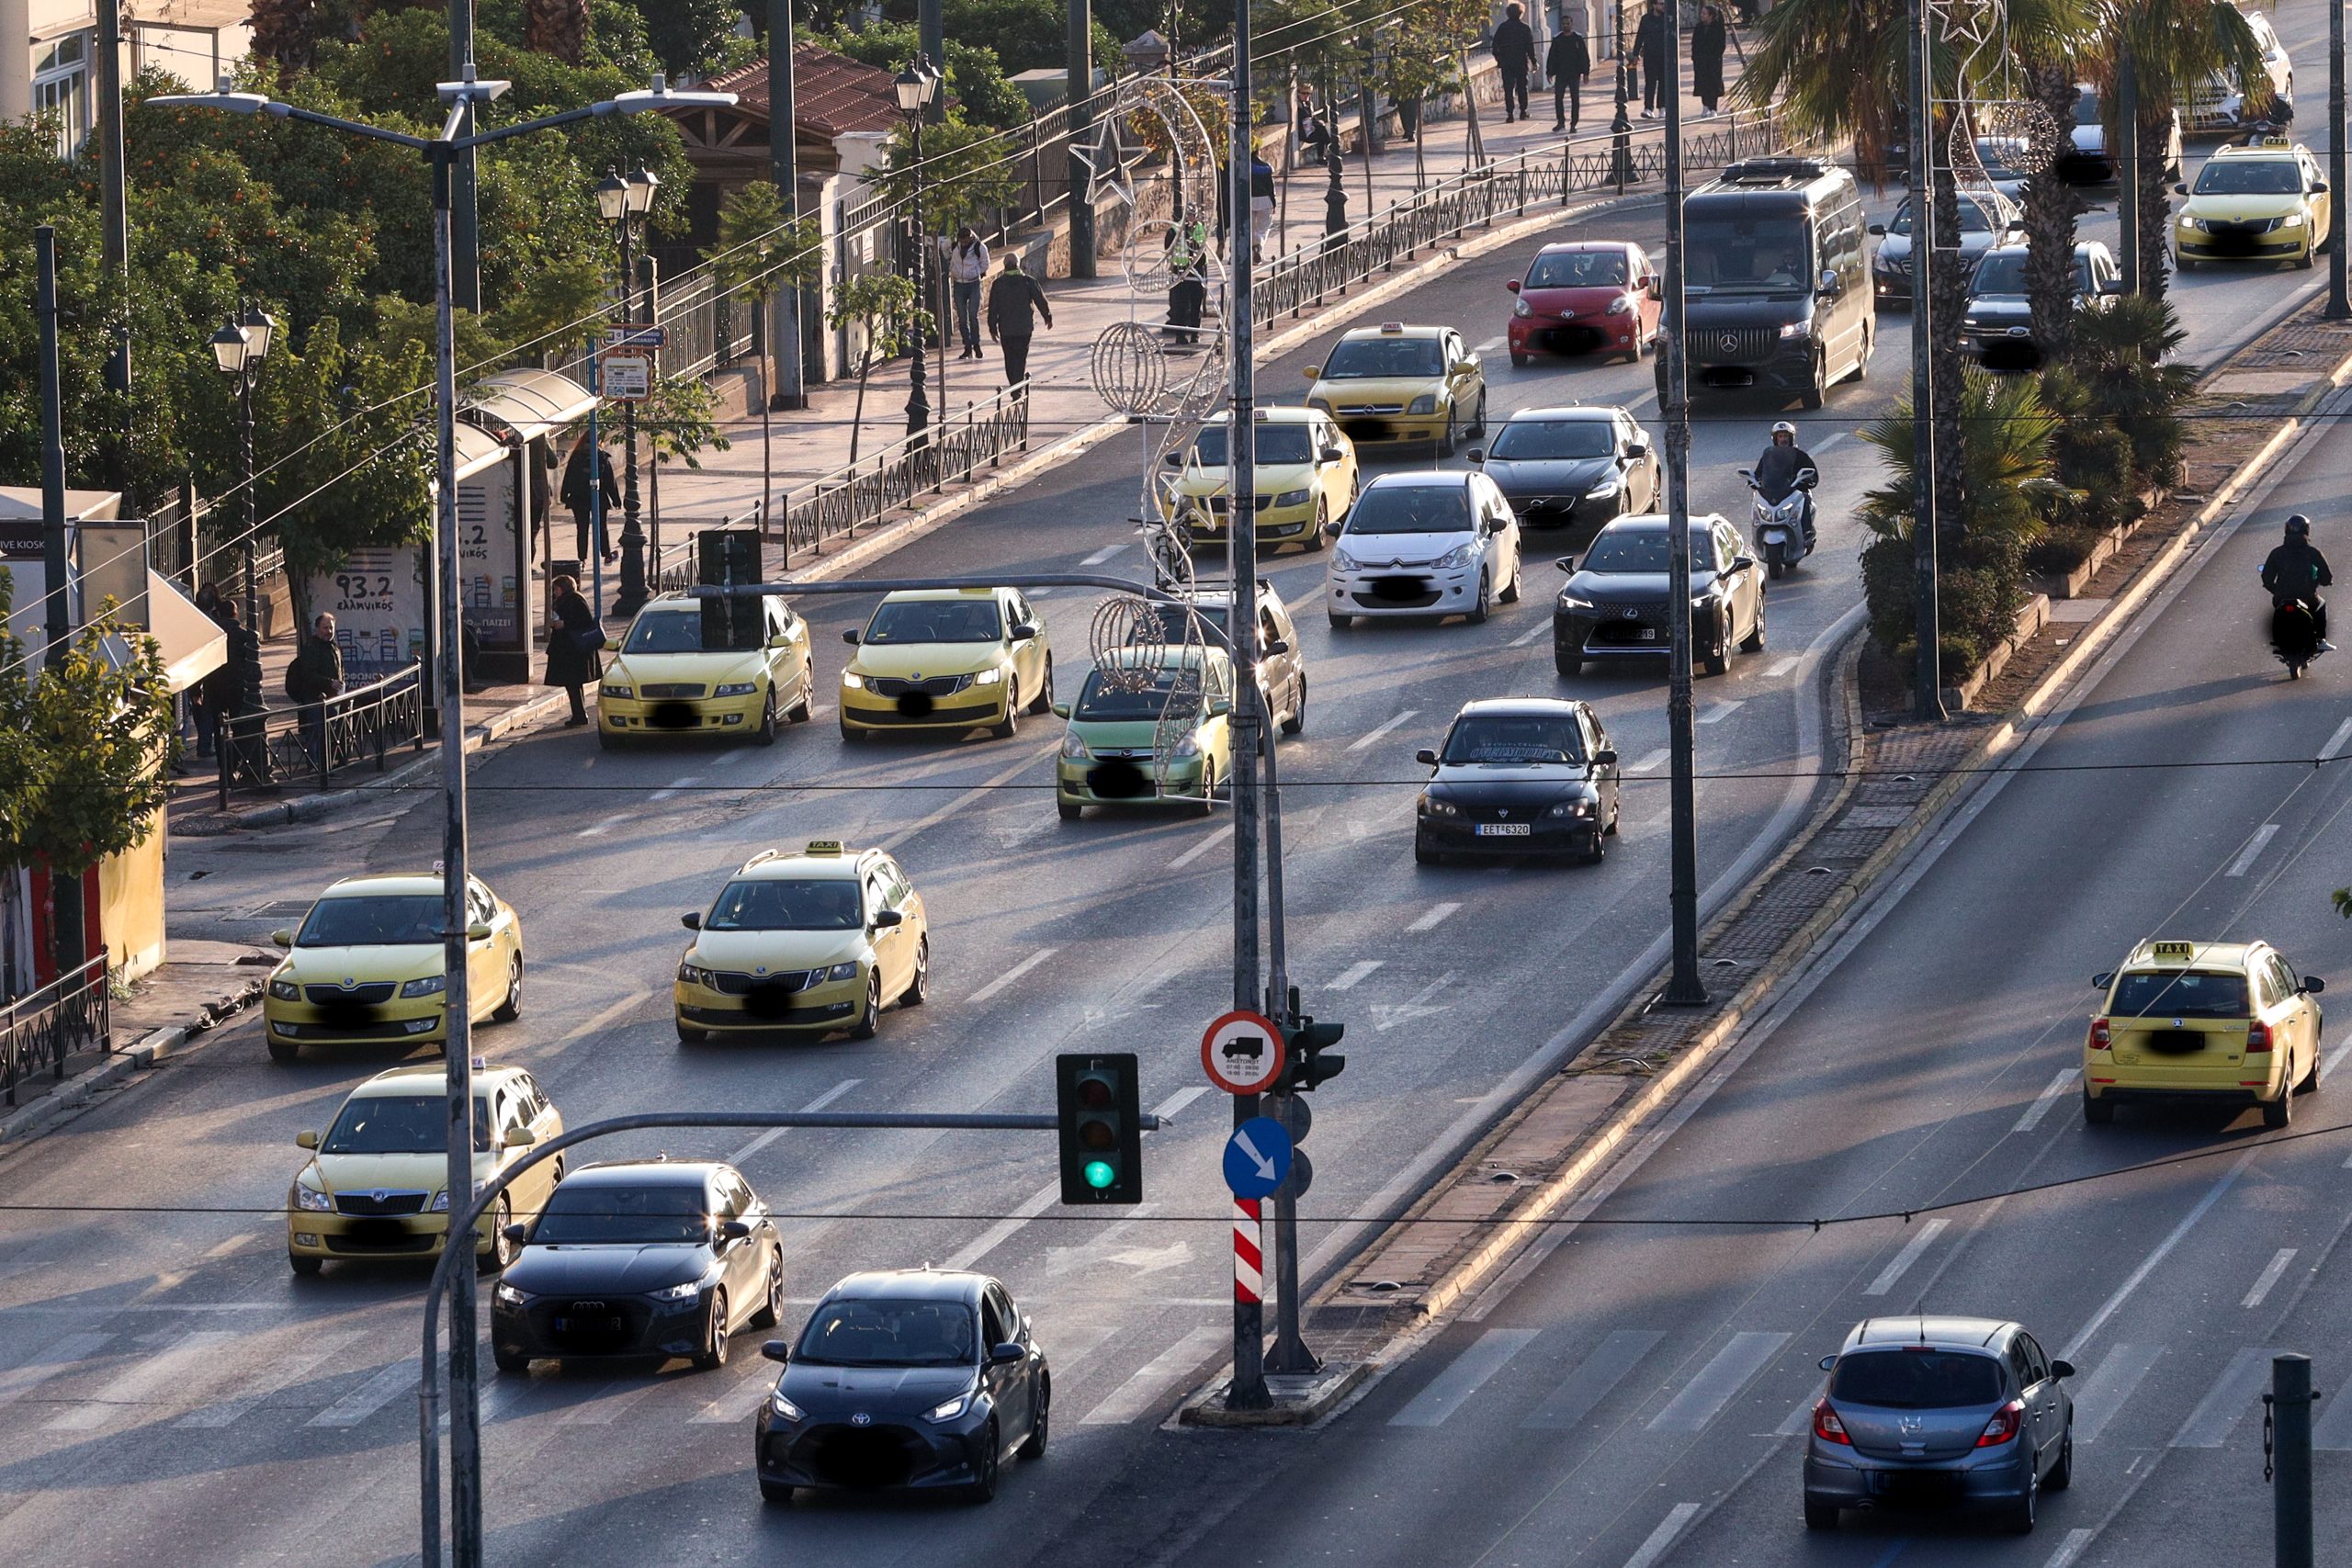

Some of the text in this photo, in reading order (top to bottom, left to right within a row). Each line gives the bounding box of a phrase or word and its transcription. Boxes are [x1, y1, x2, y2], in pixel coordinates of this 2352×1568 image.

[459, 547, 488, 559] νικός
[336, 574, 393, 599] 93.2
[336, 599, 393, 612] ελληνικός
[2157, 943, 2188, 953] TAXI
